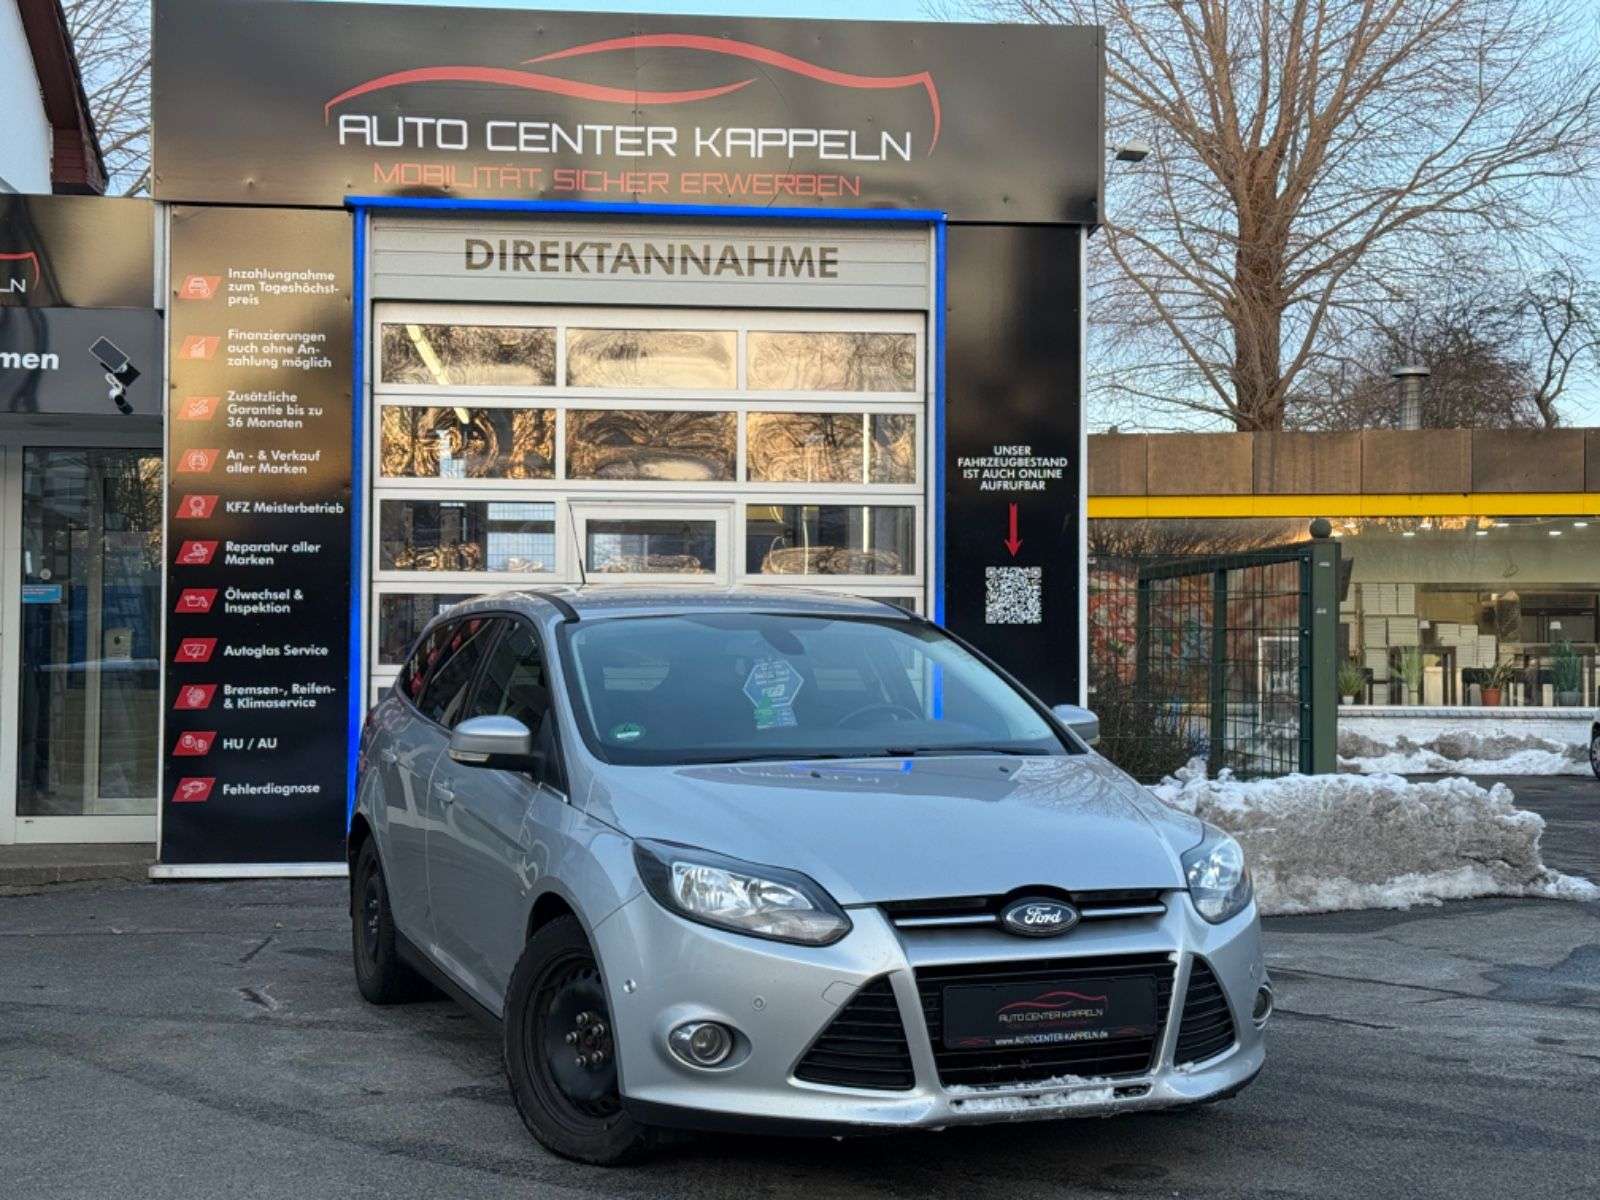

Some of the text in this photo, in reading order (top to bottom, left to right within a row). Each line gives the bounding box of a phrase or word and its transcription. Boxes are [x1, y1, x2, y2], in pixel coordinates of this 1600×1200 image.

[339, 114, 911, 161] AUTO CENTER KAPPELN
[373, 161, 860, 195] MOBILITÄT SICHER ERWERBEN
[464, 239, 839, 278] DIREKTANNAHME
[228, 269, 335, 282] Inzahlungnahme
[228, 281, 339, 295] zum Tageshöchst-
[227, 295, 259, 306] preis
[228, 329, 326, 342] Finanzierungen
[228, 344, 320, 354] auch ohne An-
[228, 356, 332, 369] zahlung möglich
[228, 391, 297, 402] Zusätzliche
[228, 405, 323, 416] Garantie bis zu
[228, 418, 302, 428] 36 Monaten
[227, 449, 244, 460] An
[259, 450, 267, 460] &
[272, 450, 320, 461] Verkauf
[994, 446, 1031, 455] UNSER
[958, 458, 1067, 467] FAHRZEUGBESTAND
[227, 463, 307, 474] aller Marken
[963, 470, 1062, 479] IST AUCH ONLINE
[980, 481, 1045, 490] AUFRUFBAR
[226, 502, 344, 514] KFZ Meisterbetrieb
[226, 542, 320, 553] Reparatur aller
[226, 554, 274, 566] Marken
[226, 587, 303, 600] Ölwechsel &
[225, 602, 290, 614] Inspektion
[224, 644, 328, 658] Autoglas Service
[292, 684, 336, 695] Reifen-
[224, 698, 316, 708] & Klimaservice
[224, 738, 244, 749] HU
[258, 738, 277, 748] AU
[223, 784, 320, 796] Fehlerdiagnose
[1024, 906, 1062, 924] Ford
[999, 1013, 1023, 1023] AUTO
